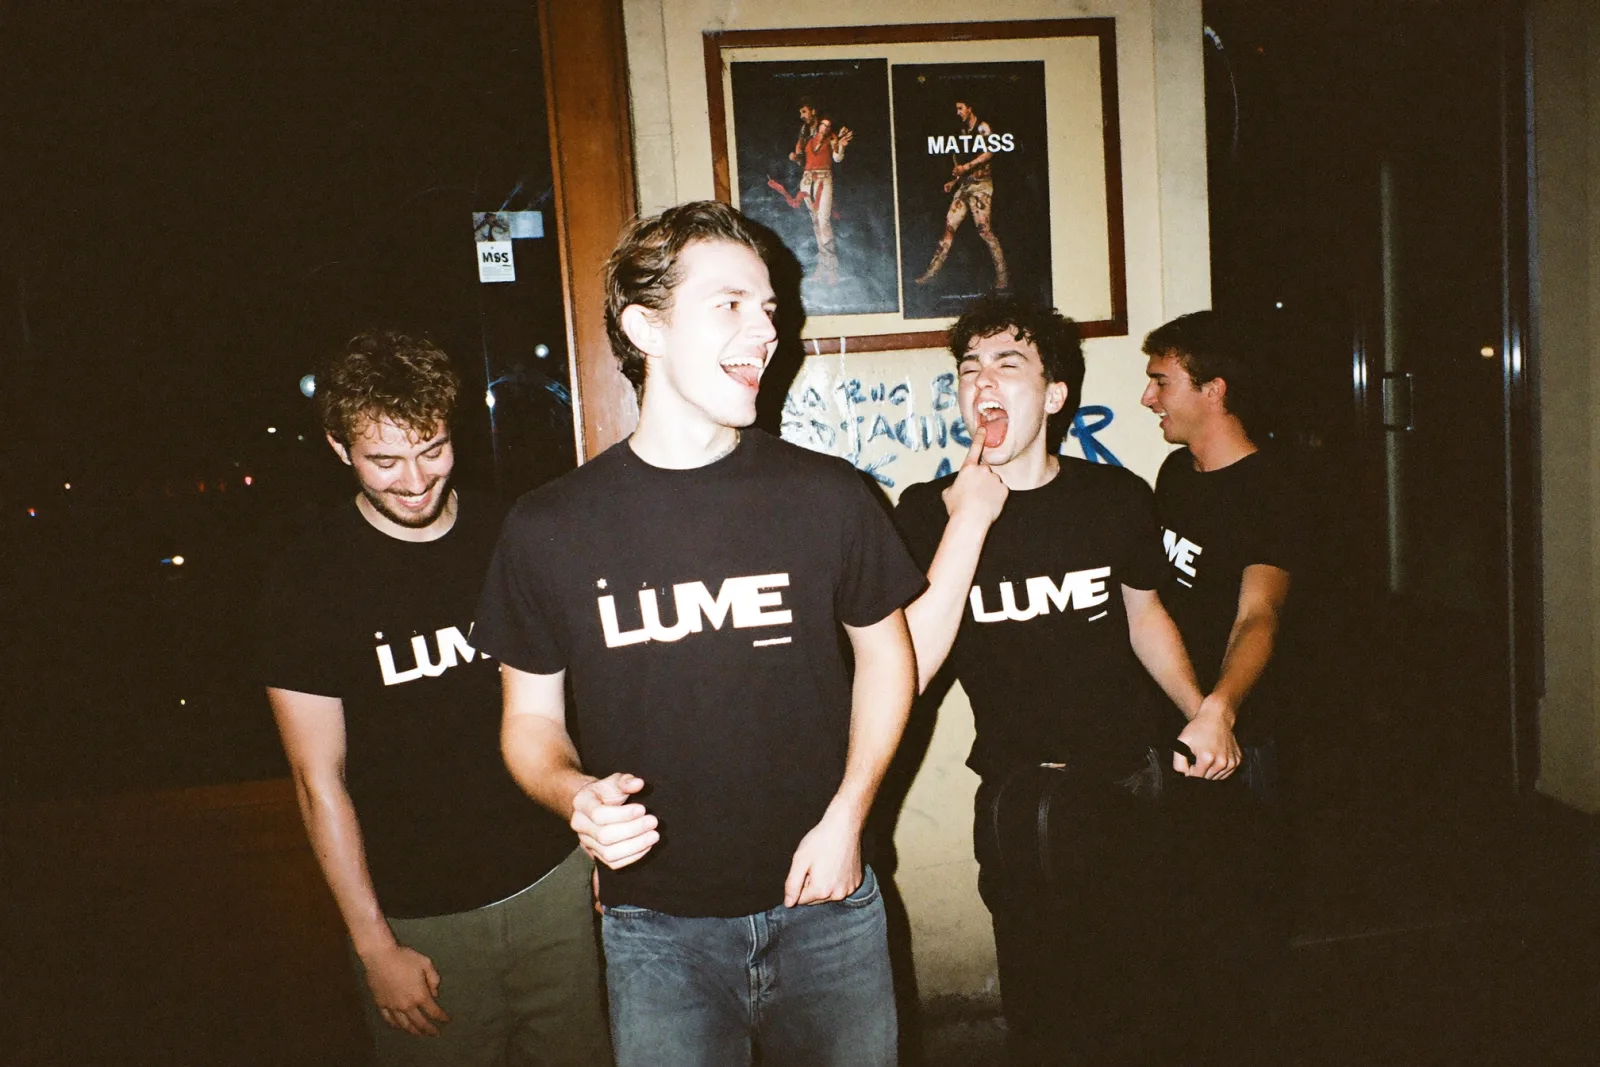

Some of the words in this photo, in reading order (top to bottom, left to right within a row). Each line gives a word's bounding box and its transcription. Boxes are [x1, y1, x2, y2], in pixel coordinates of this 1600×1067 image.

[928, 132, 1015, 155] MATASS
[969, 565, 1111, 623] LUME
[375, 622, 484, 686] LUM
